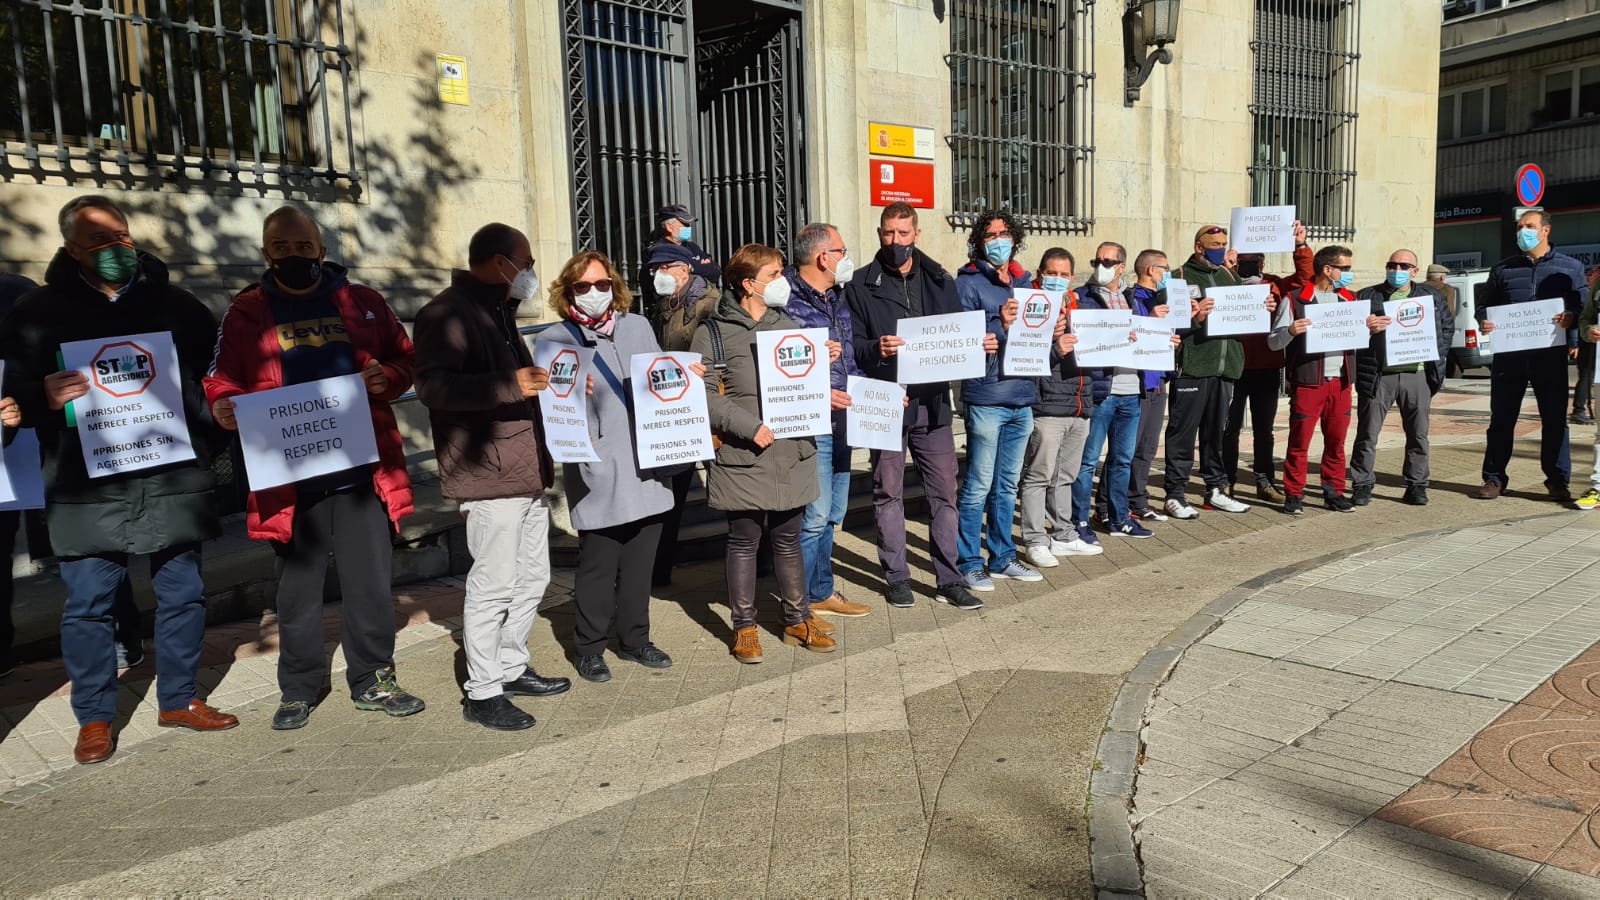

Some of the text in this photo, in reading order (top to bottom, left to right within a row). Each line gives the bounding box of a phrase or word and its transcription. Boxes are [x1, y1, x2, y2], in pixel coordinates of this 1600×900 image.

[1454, 207, 1482, 216] Banco
[922, 323, 960, 335] NO MÁS
[905, 338, 978, 352] AGRESIONES EN
[780, 358, 812, 367] AGRESIONES
[919, 354, 966, 366] PRISIONES
[102, 370, 150, 385] AGRESIONES
[654, 380, 686, 391] AGRESIONES
[768, 384, 805, 392] #PRISIONES
[797, 393, 824, 401] RESPETO
[864, 390, 890, 401] NO MÁS
[85, 402, 143, 418] #PRISIONES
[269, 396, 340, 420] PRISIONES
[655, 406, 691, 416] PRISIONES
[851, 404, 899, 418] AGRESIONES EN
[88, 411, 175, 432] MERECE RESPETO
[643, 416, 704, 430] MERECE RESPETO
[770, 413, 807, 423] #PRISIONES
[282, 417, 337, 439] MERECE
[860, 420, 890, 432] PRISIONES
[93, 436, 174, 456] #PRISIONES SIN
[284, 437, 343, 461] RESPETO
[650, 439, 687, 450] PRISIONES
[97, 452, 161, 470] AGRESIONES
[656, 450, 700, 462] AGRESIONES
